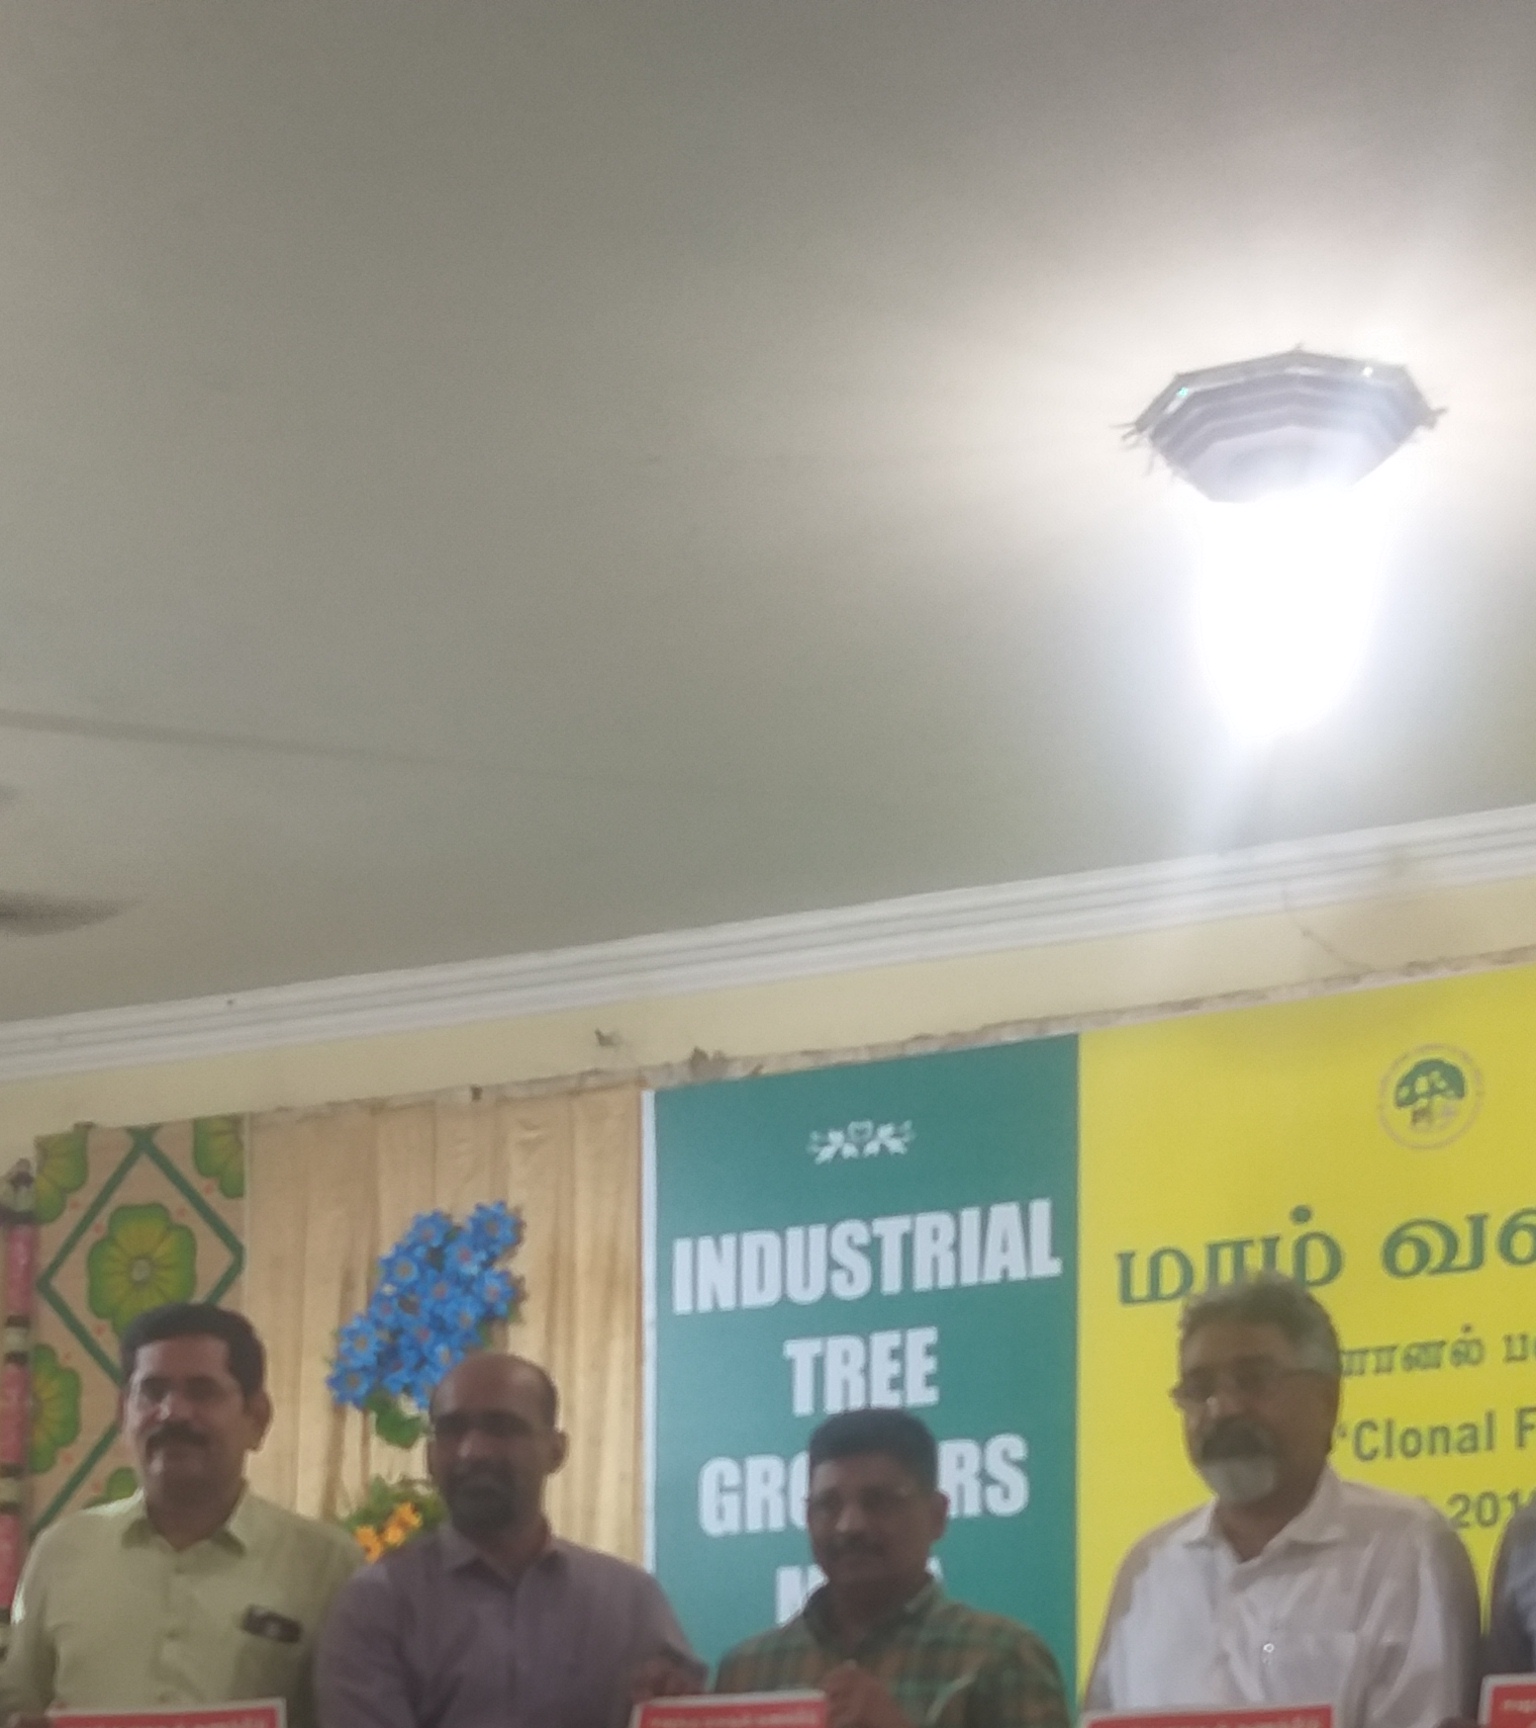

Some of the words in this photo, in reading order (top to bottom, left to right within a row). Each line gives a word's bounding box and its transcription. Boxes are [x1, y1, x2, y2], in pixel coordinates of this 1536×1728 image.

[671, 1197, 1064, 1317] INDUSTRIAL
[782, 1325, 940, 1418] TREE
[697, 1432, 1030, 1537] GRRS
